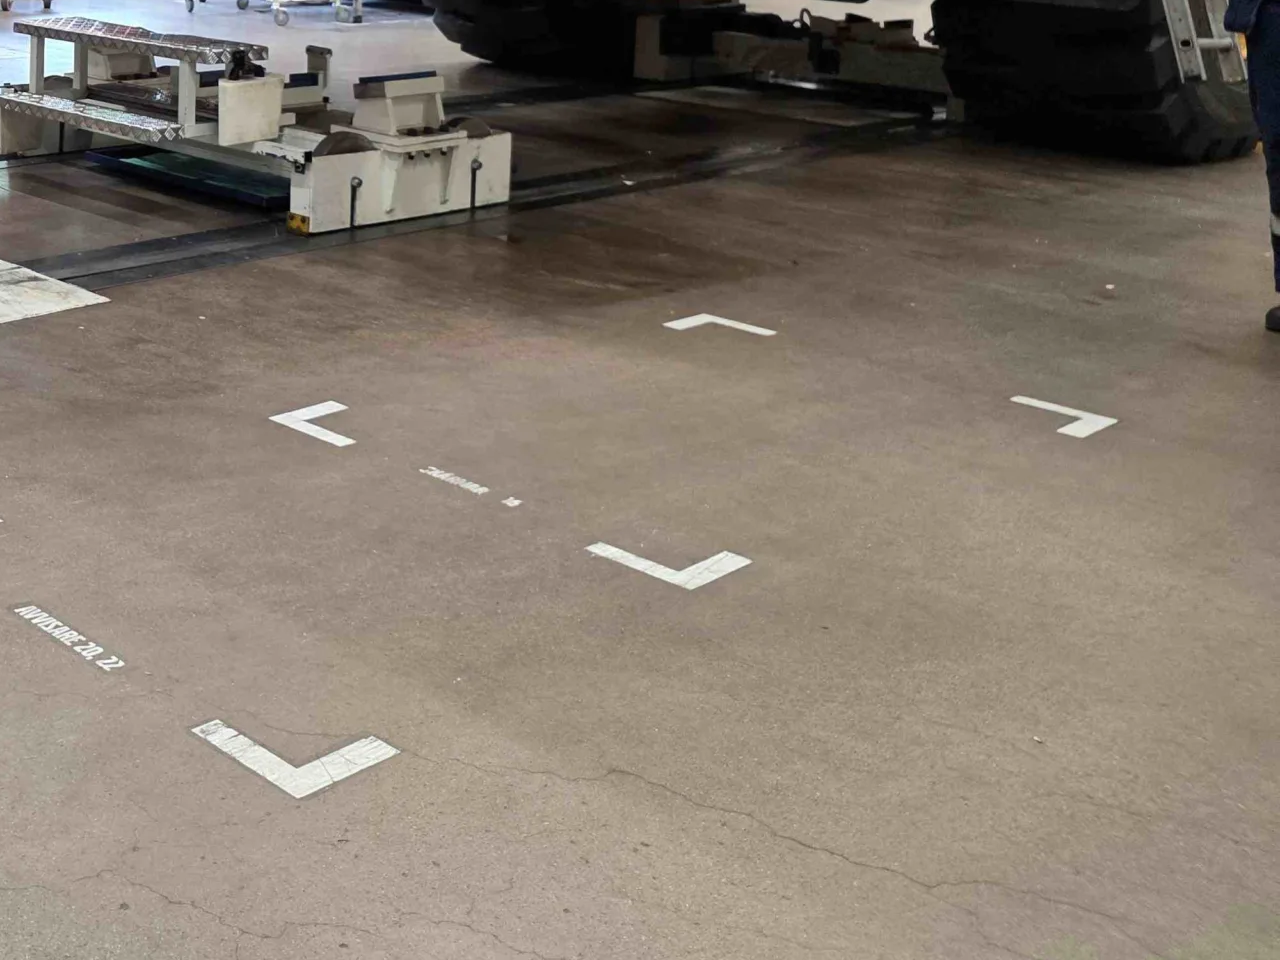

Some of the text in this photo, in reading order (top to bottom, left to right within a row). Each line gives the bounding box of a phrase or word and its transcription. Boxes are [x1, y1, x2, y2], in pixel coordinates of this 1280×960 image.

[13, 605, 125, 672] AVVISARE 20, 22
